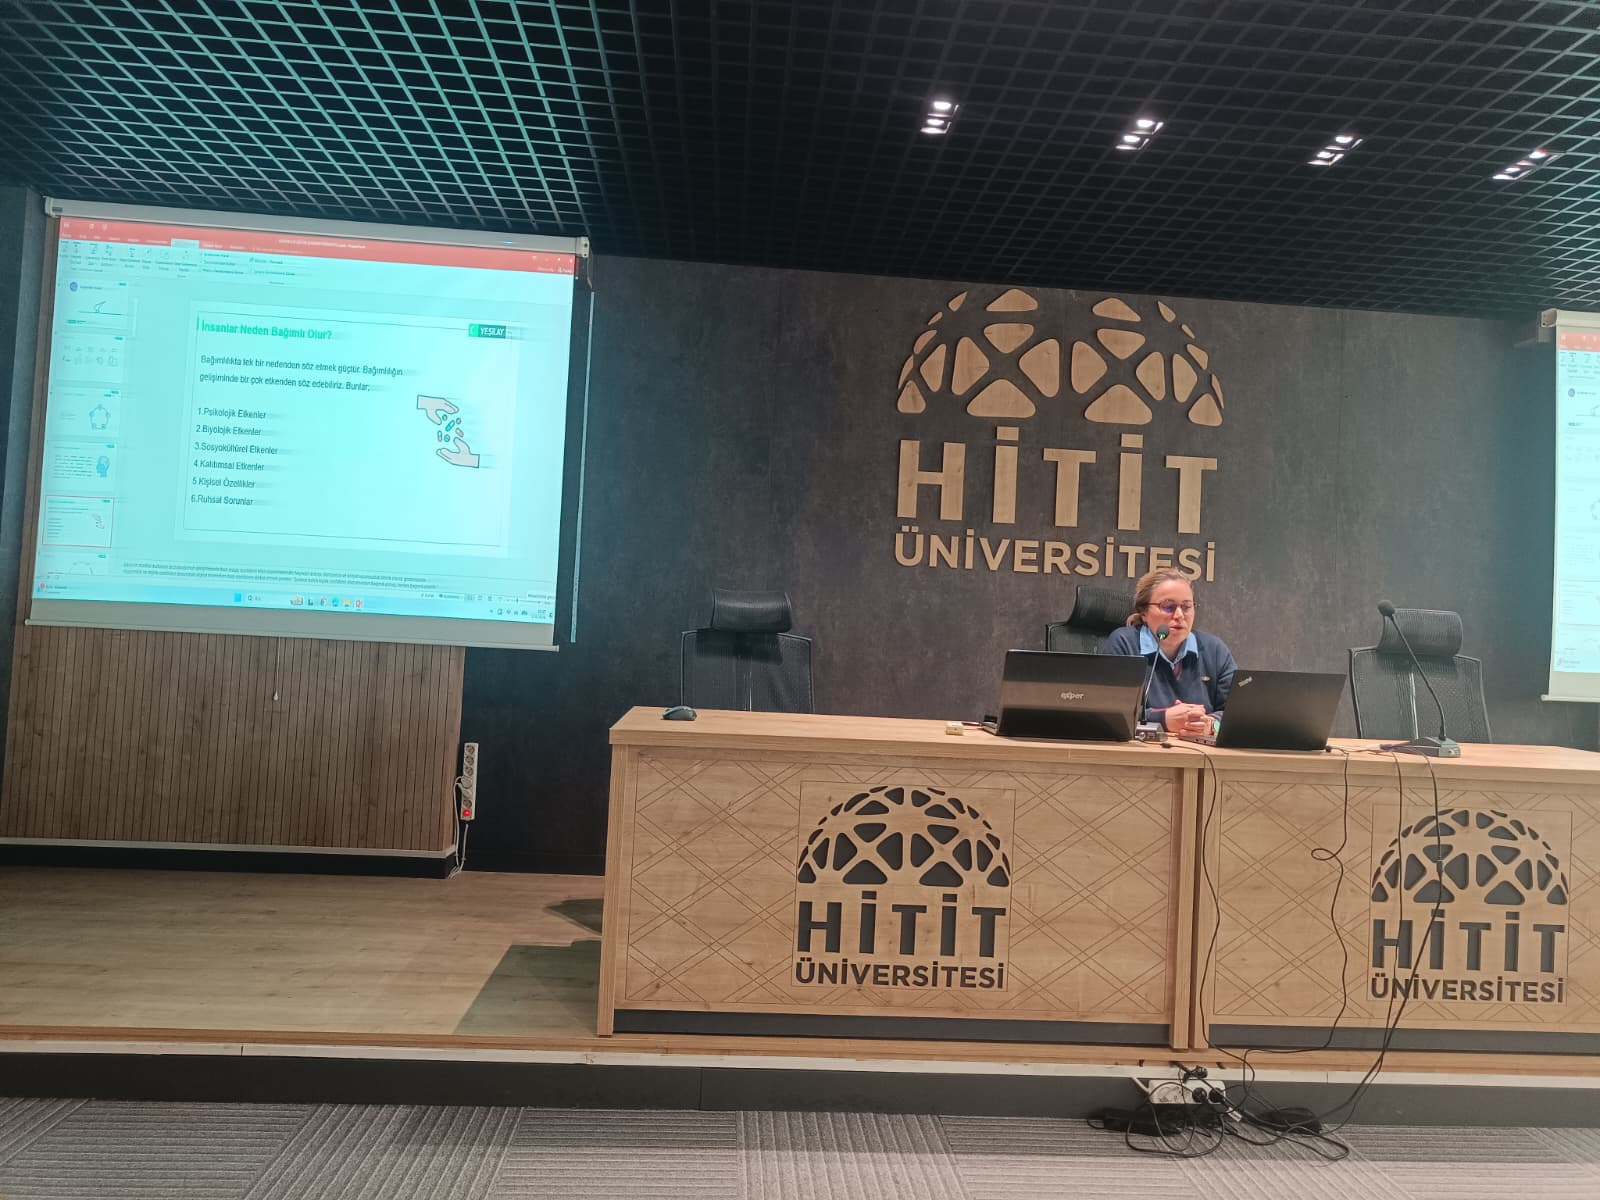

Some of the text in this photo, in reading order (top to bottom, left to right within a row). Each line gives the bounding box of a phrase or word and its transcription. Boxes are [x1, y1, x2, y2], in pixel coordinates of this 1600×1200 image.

[201, 319, 333, 340] İnsanlar Neden Bağımlı Olur?
[200, 354, 242, 366] Bağımlılıkta
[242, 357, 254, 366] tek
[255, 359, 265, 367] bir
[265, 360, 301, 370] nedenden
[301, 362, 314, 371] söz
[315, 363, 337, 373] etmek
[199, 372, 240, 385] gelişiminde
[240, 376, 250, 384] bir
[250, 377, 264, 386] çok
[264, 378, 297, 387] etkenden
[297, 379, 311, 388] söz
[198, 407, 267, 420] 1.Psikolojik Etkenler
[195, 424, 262, 437] 2.Biyolojik Etkenler
[194, 441, 279, 455] 3.Sosyokültürel Etkenler
[235, 461, 265, 472] Etkenler
[222, 477, 256, 489] Özellikler
[896, 425, 1218, 534] HİTİT
[190, 494, 254, 506] 6.Ruhsal Sorunlar
[894, 524, 1216, 583] ÜNİVERSİTESİ
[797, 890, 1007, 958] HİTİT
[1371, 908, 1566, 974] HİTİT
[795, 956, 1005, 989] ÜNİVERSİTESİ
[1370, 972, 1564, 1004] ÜNİVERSİTESİ
